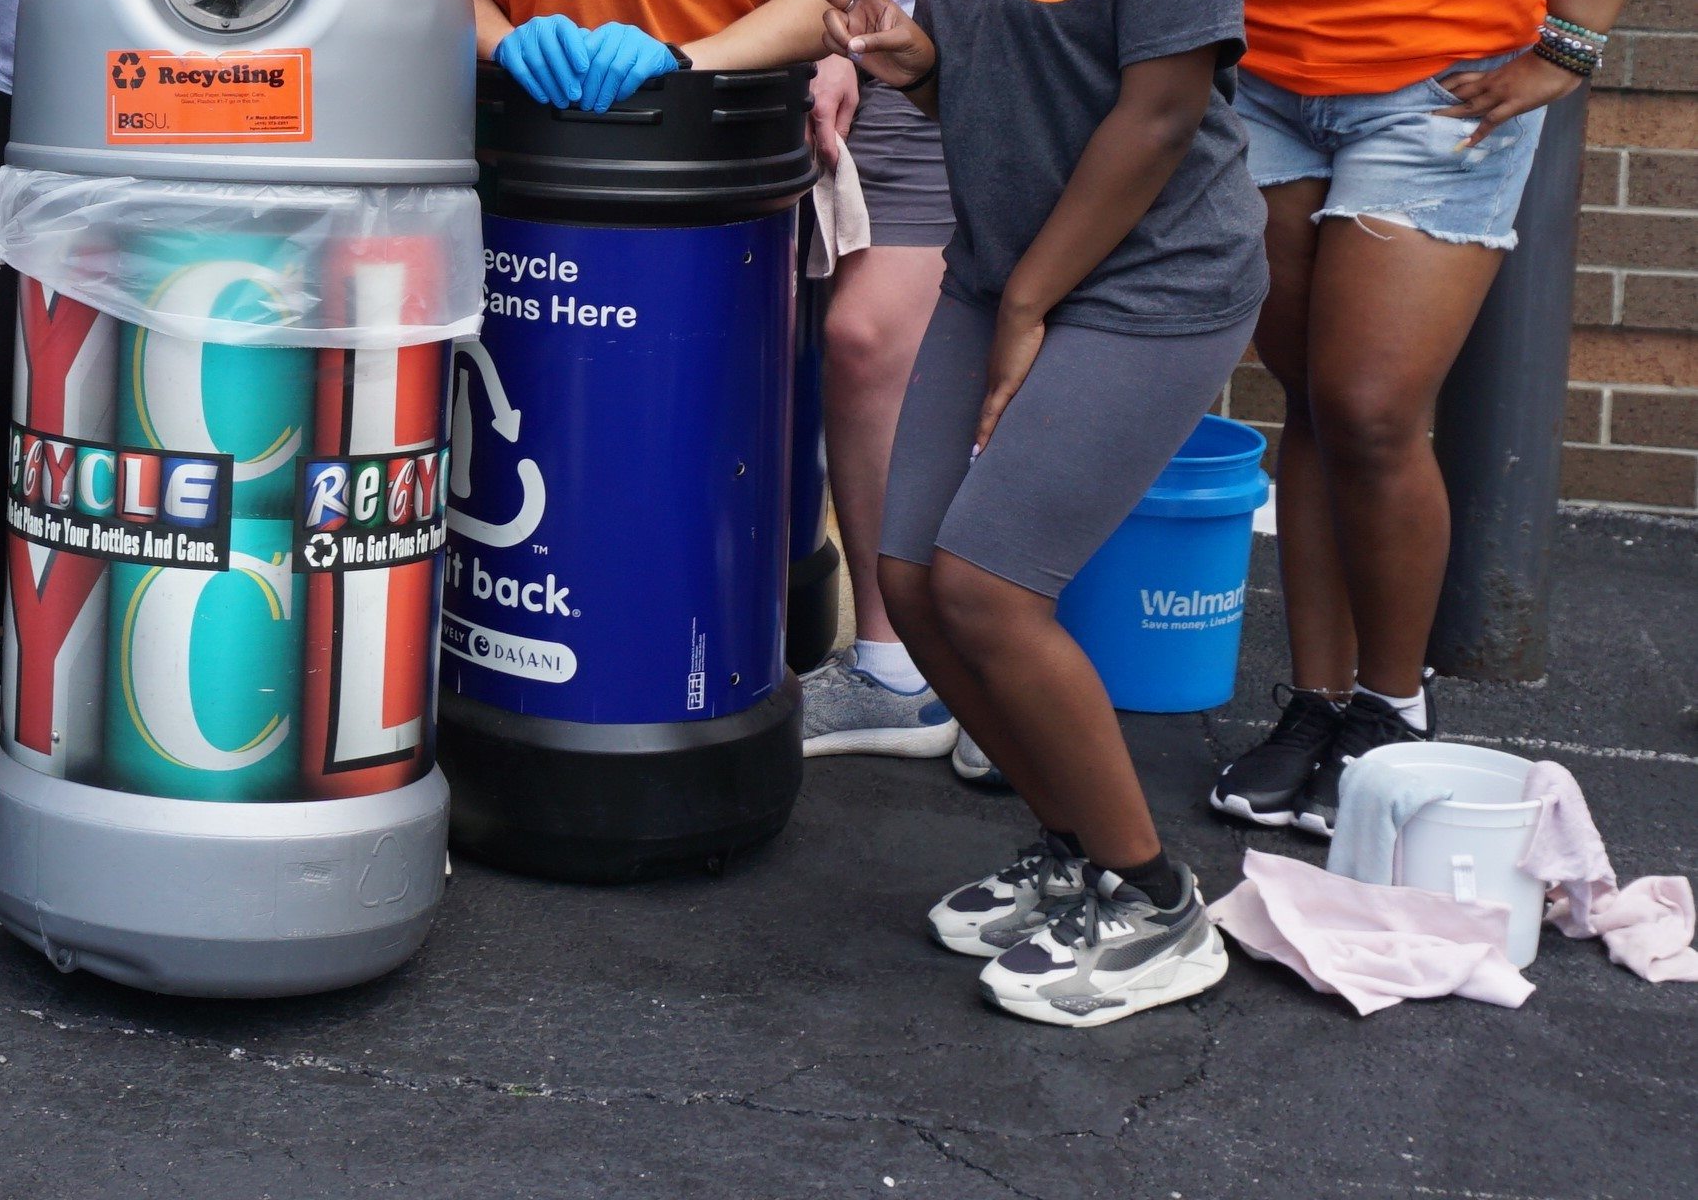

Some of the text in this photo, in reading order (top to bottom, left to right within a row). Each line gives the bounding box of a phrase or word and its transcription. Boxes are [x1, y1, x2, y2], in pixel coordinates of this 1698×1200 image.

[158, 64, 285, 88] Recycling
[118, 112, 167, 129] BGSU
[484, 248, 579, 283] ecycle
[551, 294, 638, 328] Here
[23, 506, 43, 538] Plans
[45, 513, 62, 542] For
[63, 518, 90, 548] Your
[92, 523, 140, 557] Bottles
[143, 530, 173, 560] And
[177, 533, 219, 563] Cans.
[342, 537, 364, 564] We
[367, 535, 387, 562] Got
[389, 532, 414, 560] Plans
[416, 528, 430, 554] For
[532, 544, 549, 555] TM
[445, 545, 464, 589] it
[1142, 619, 1169, 630] Save
[1170, 620, 1208, 631] money.
[1209, 617, 1227, 628] Live
[494, 643, 561, 671] DASANI
